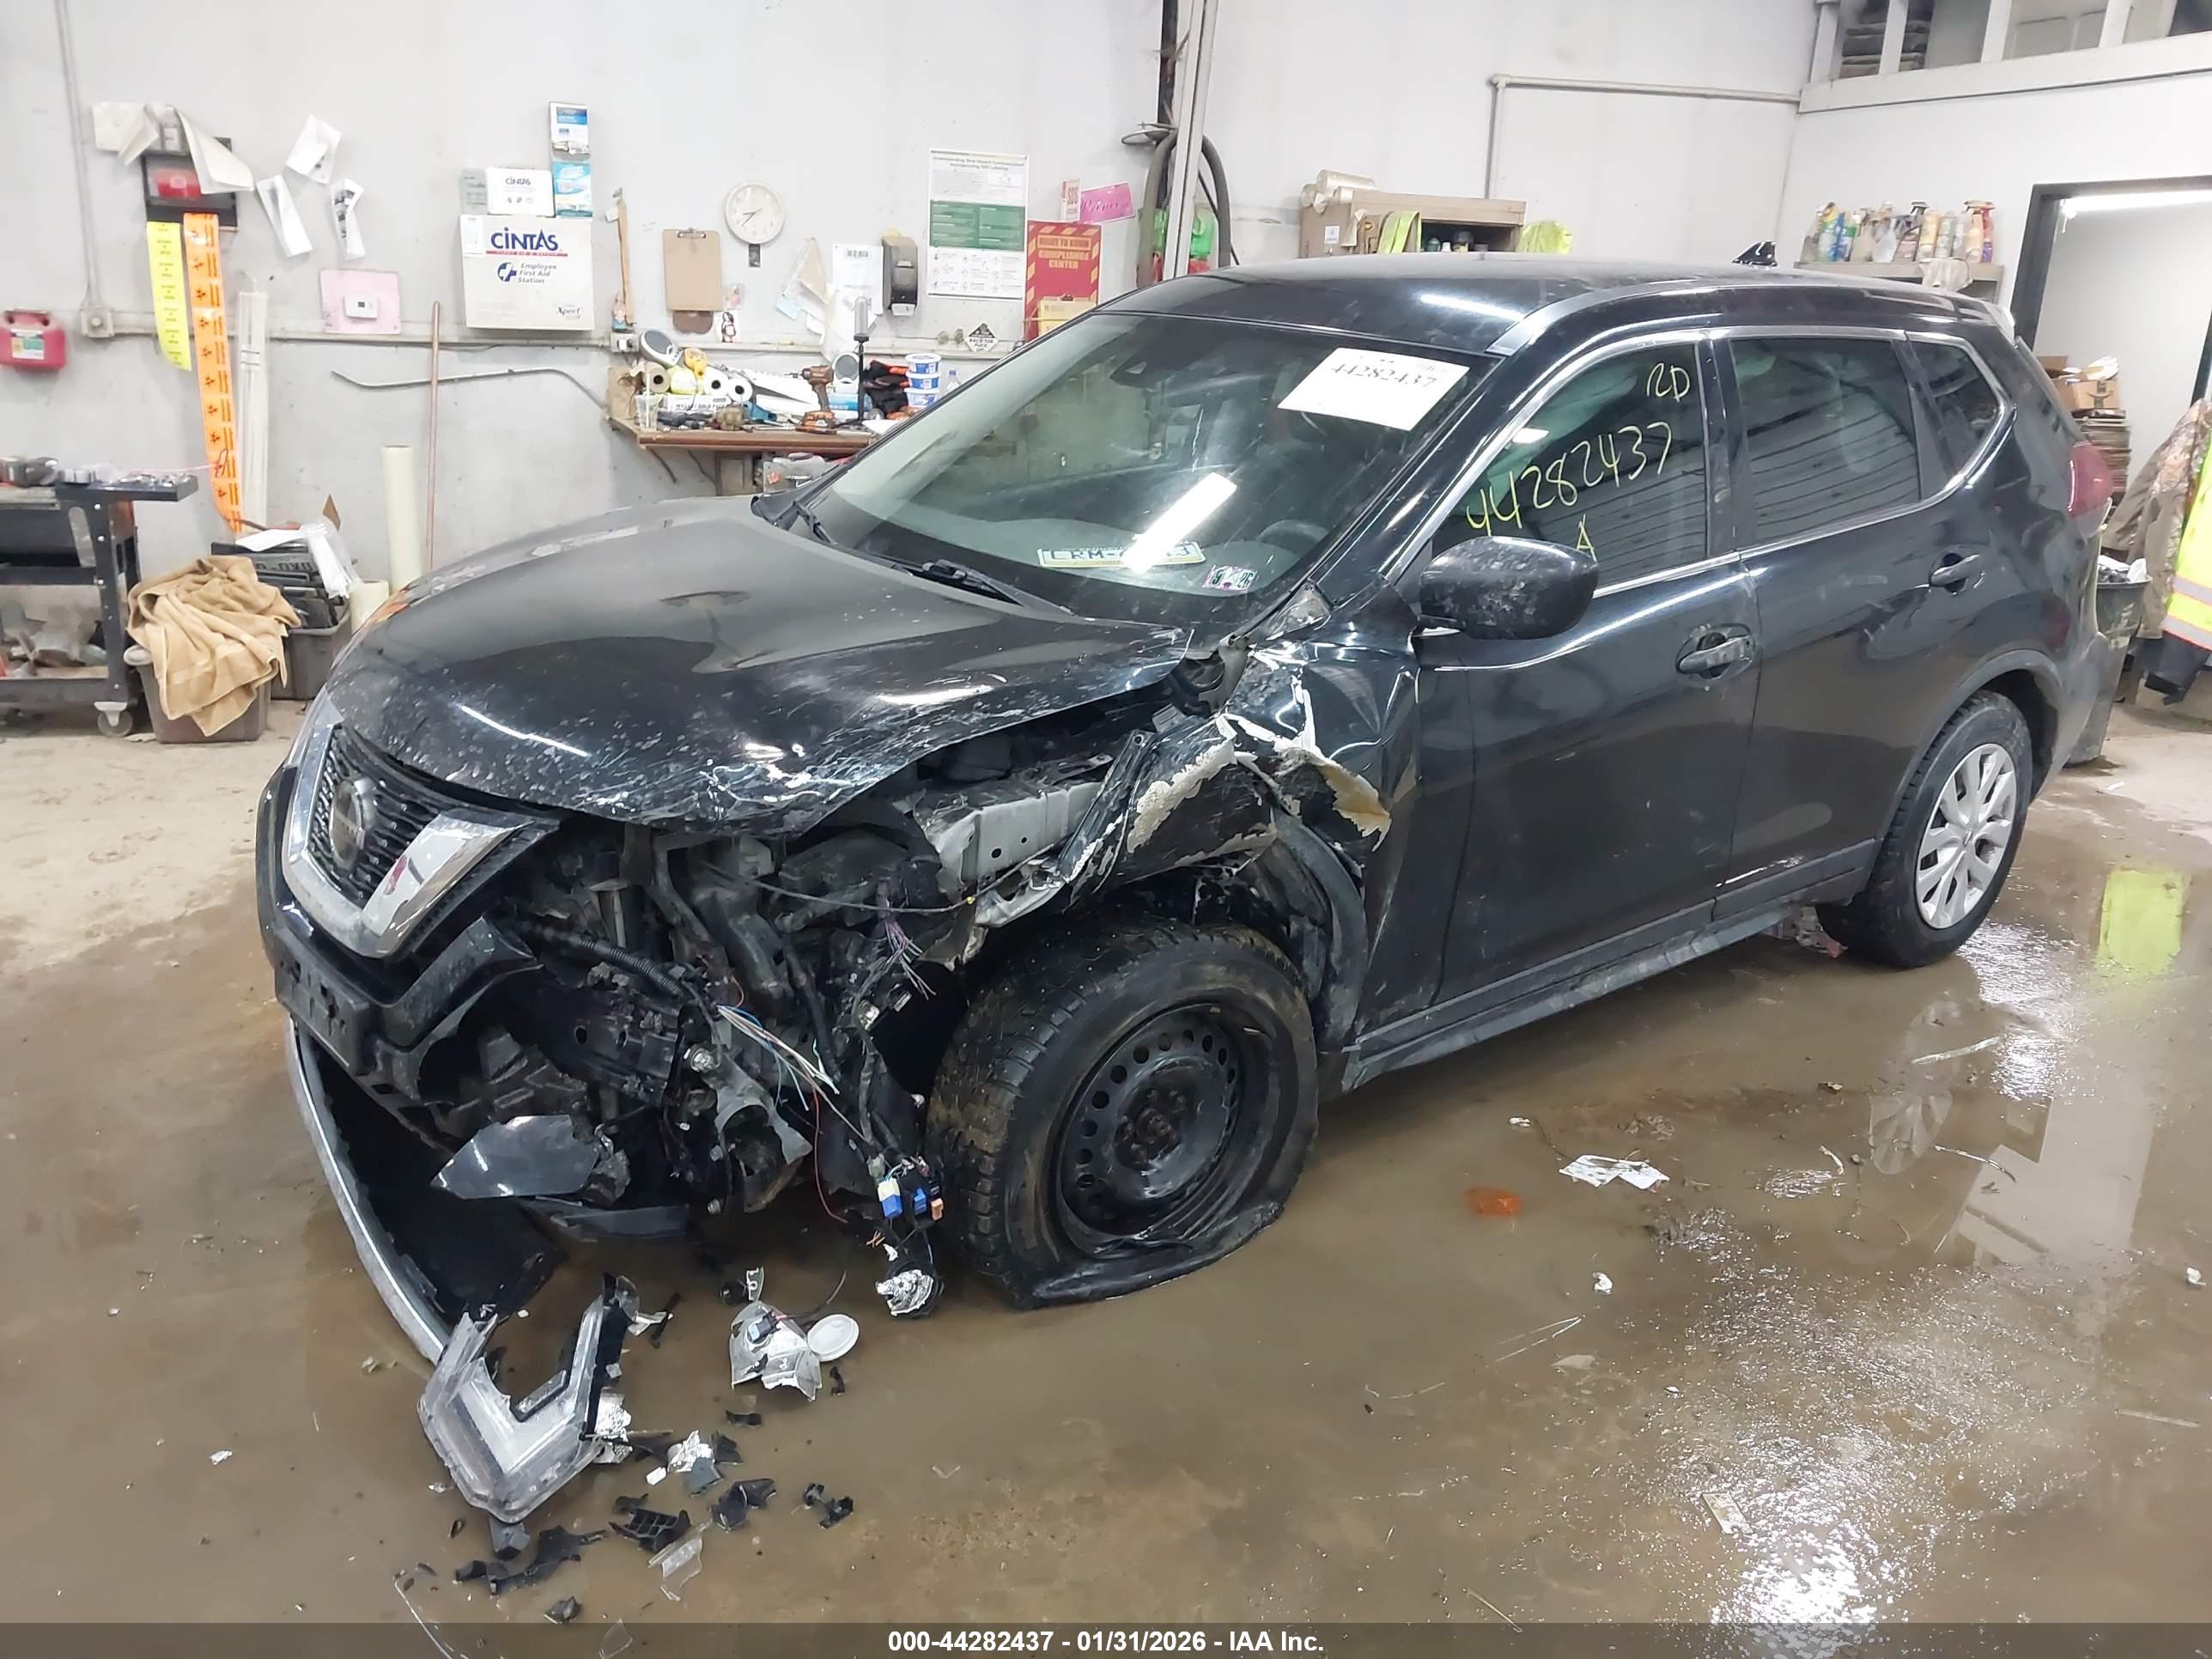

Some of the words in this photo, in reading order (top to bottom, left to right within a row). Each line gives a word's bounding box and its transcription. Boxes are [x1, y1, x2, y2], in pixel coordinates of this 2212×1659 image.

[490, 227, 558, 252] CINTAS
[520, 262, 556, 272] Employee
[1331, 363, 1437, 388] 44282437
[1466, 421, 1672, 537] 44282437
